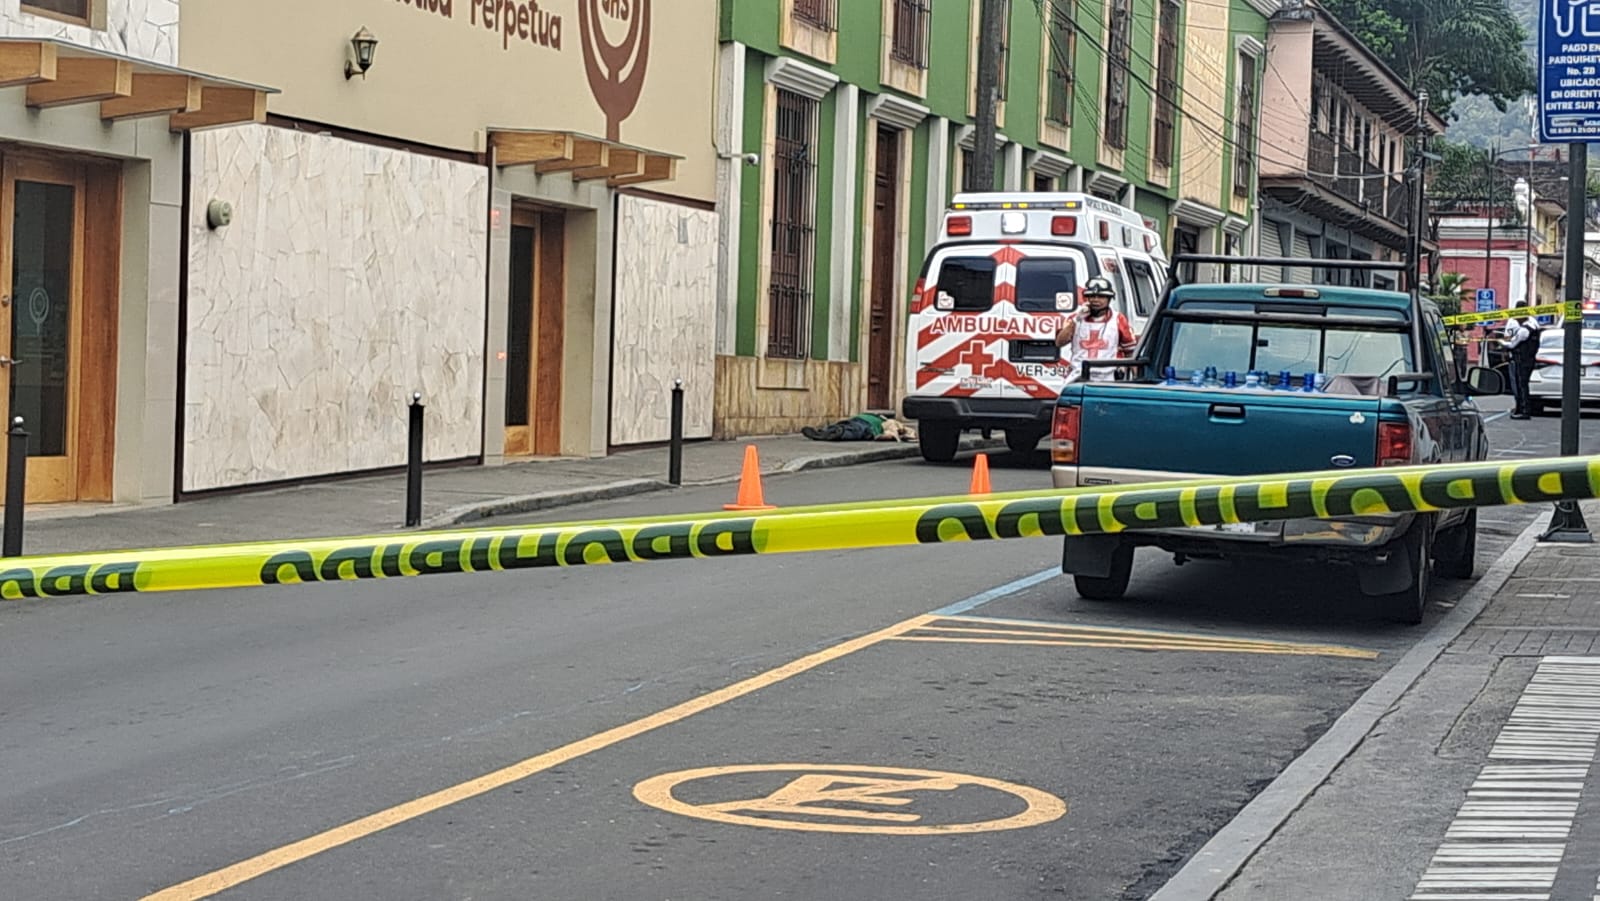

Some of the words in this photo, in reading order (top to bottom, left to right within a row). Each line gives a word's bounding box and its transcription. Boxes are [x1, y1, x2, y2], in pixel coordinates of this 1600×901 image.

[470, 0, 562, 50] Perpetua
[1562, 44, 1587, 53] PAGO
[1575, 101, 1595, 110] SUR
[931, 317, 1066, 333] AMBULANCI
